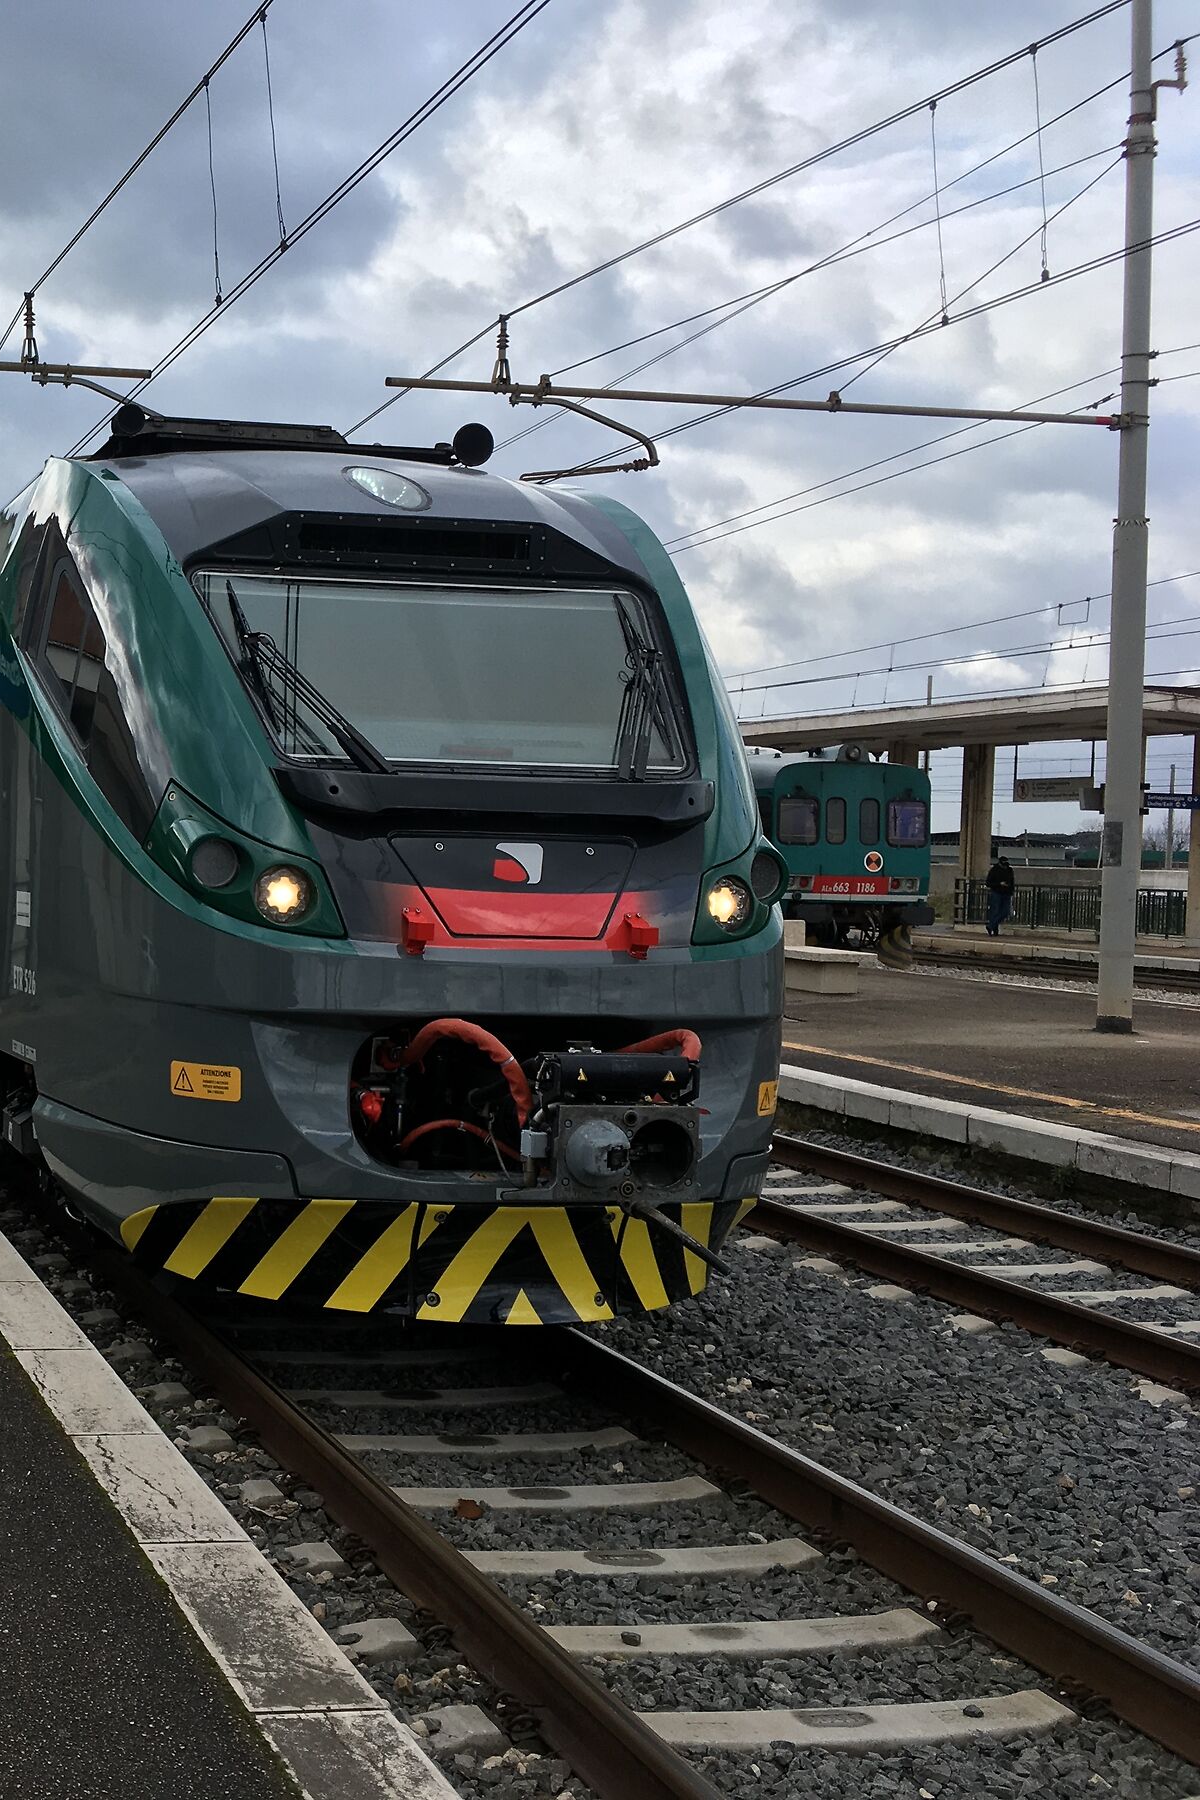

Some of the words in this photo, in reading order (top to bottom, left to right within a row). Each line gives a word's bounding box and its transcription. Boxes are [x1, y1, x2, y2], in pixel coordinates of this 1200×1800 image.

[833, 882, 850, 892] 663
[857, 882, 875, 893] 1186
[13, 965, 24, 991] ETR
[24, 968, 36, 996] 526
[200, 1068, 232, 1078] ATTENZIONE
